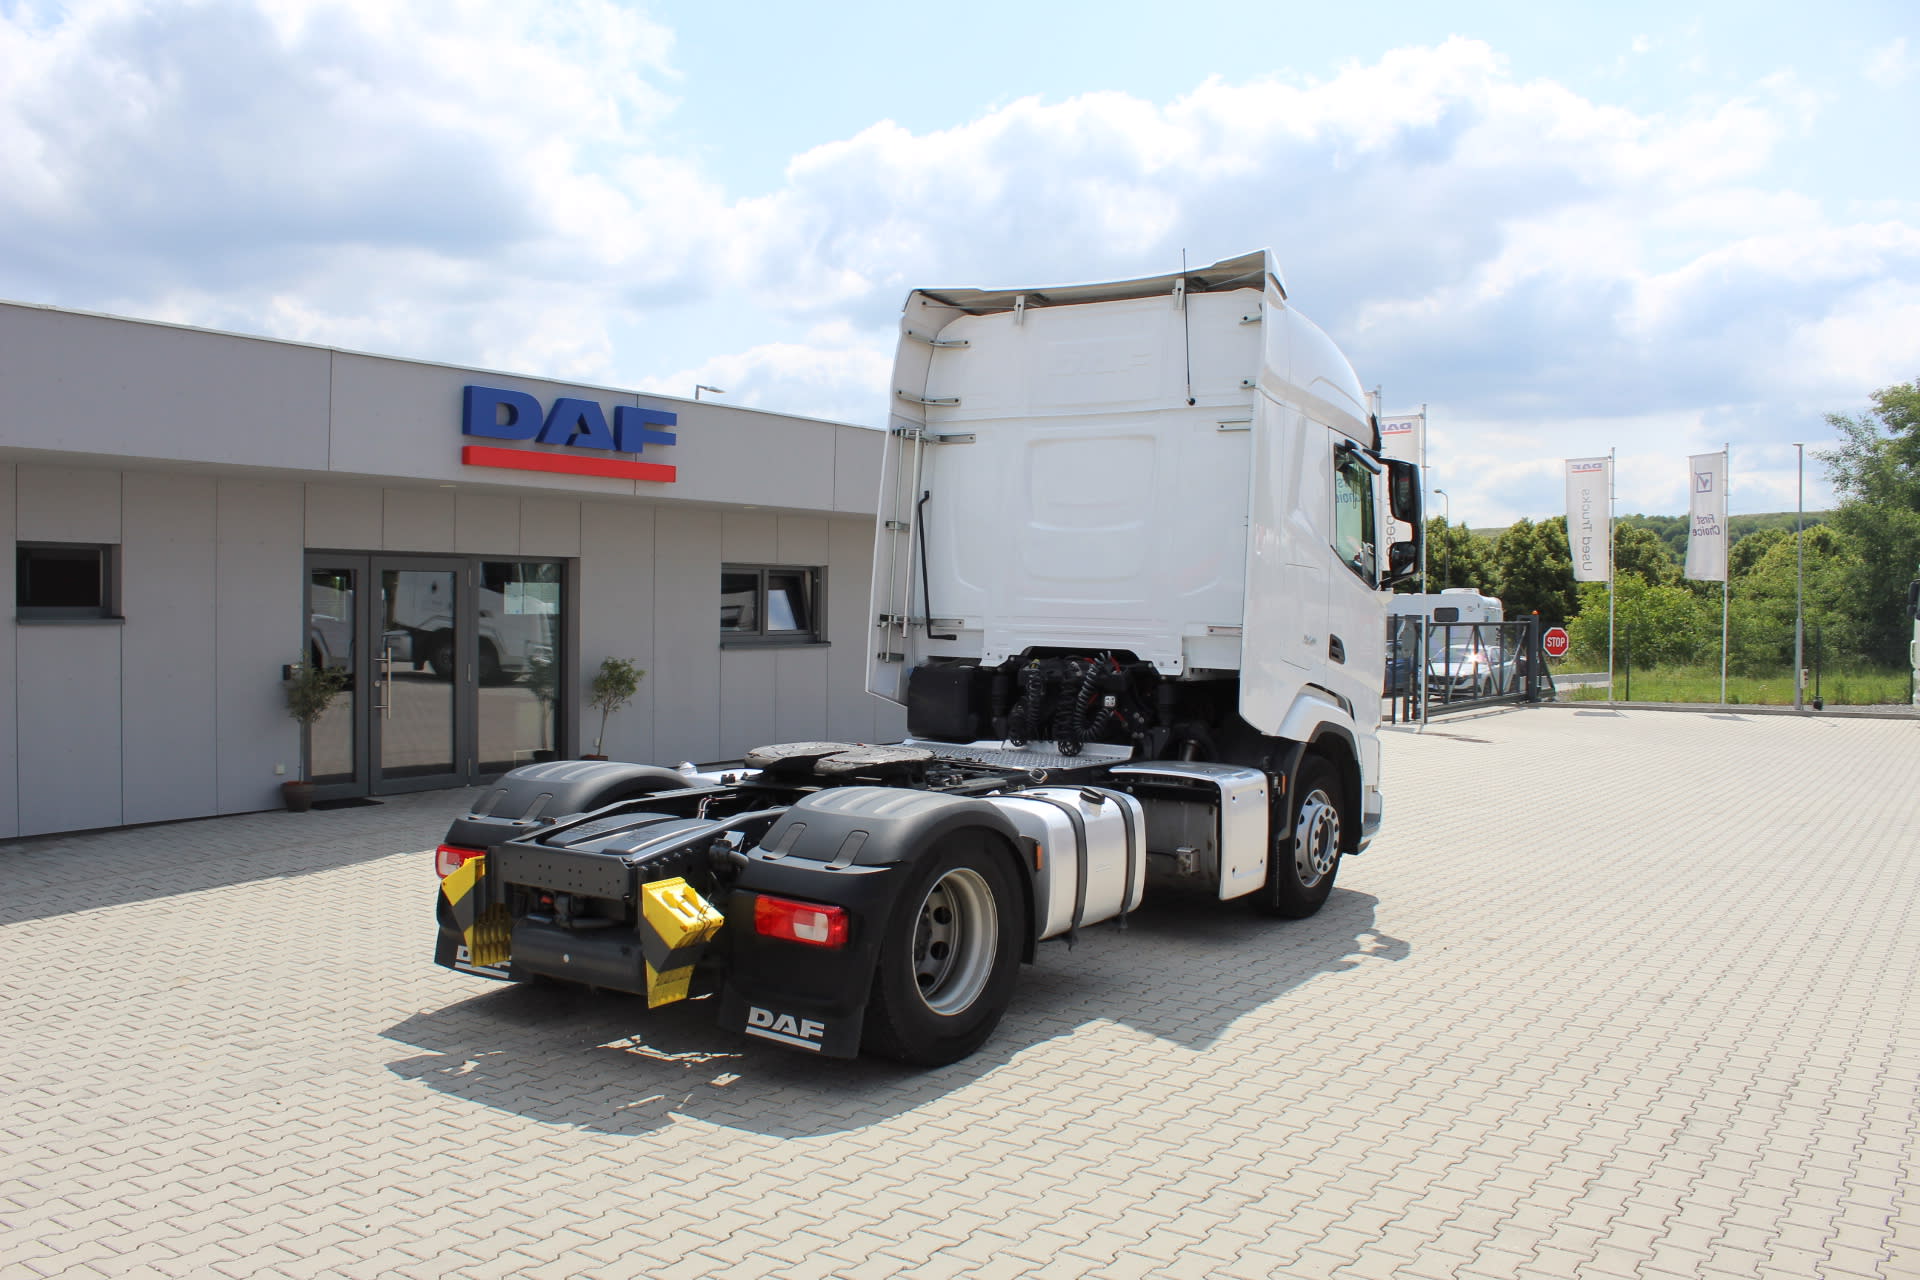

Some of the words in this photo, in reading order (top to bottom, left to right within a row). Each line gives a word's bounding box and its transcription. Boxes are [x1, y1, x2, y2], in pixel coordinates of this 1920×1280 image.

[463, 385, 677, 454] DAF
[1546, 636, 1565, 648] STOP
[747, 1006, 825, 1039] DAF
